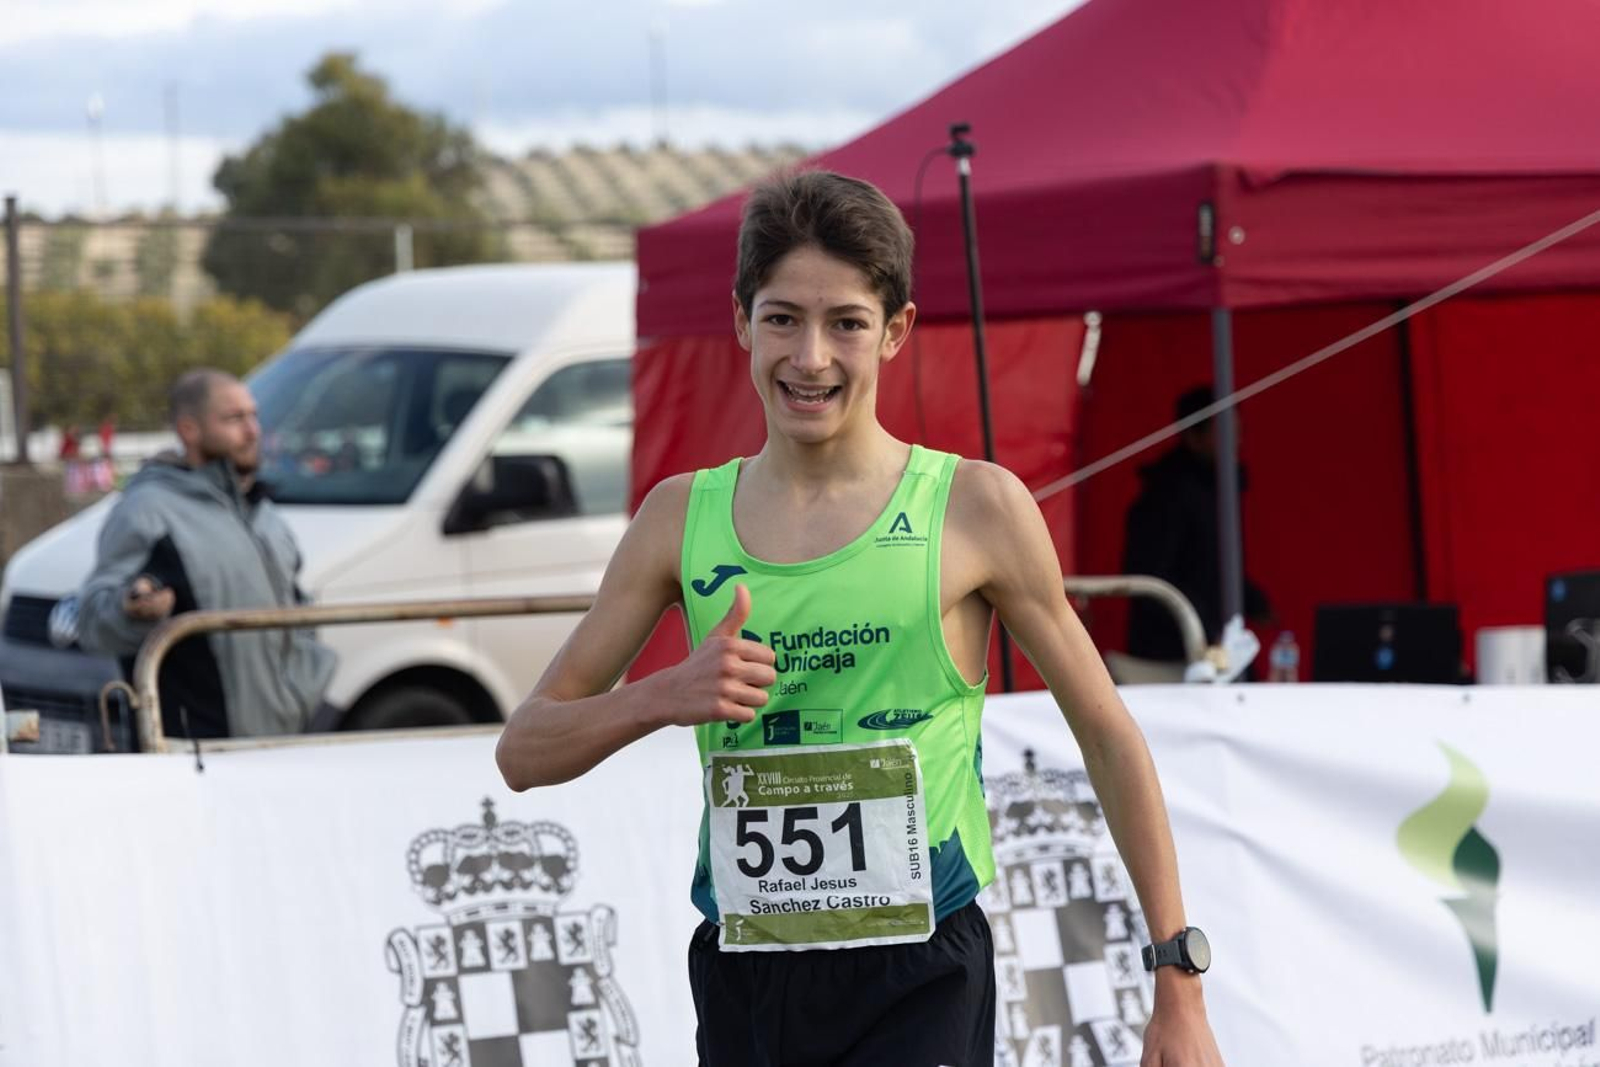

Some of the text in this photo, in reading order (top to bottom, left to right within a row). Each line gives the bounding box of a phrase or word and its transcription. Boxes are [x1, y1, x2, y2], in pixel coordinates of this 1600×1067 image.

[770, 623, 890, 651] Fundación
[775, 648, 855, 674] Unicaja
[757, 772, 781, 786] XXVIII
[809, 774, 842, 784] Provincial
[758, 781, 854, 797] Campo a través
[904, 772, 921, 880] SUB16 Masculino
[736, 802, 867, 878] 551
[758, 878, 857, 893] Rafael Jesus
[750, 895, 891, 915] Sanchez Castro
[1360, 1017, 1596, 1067] Patronato Municipal
